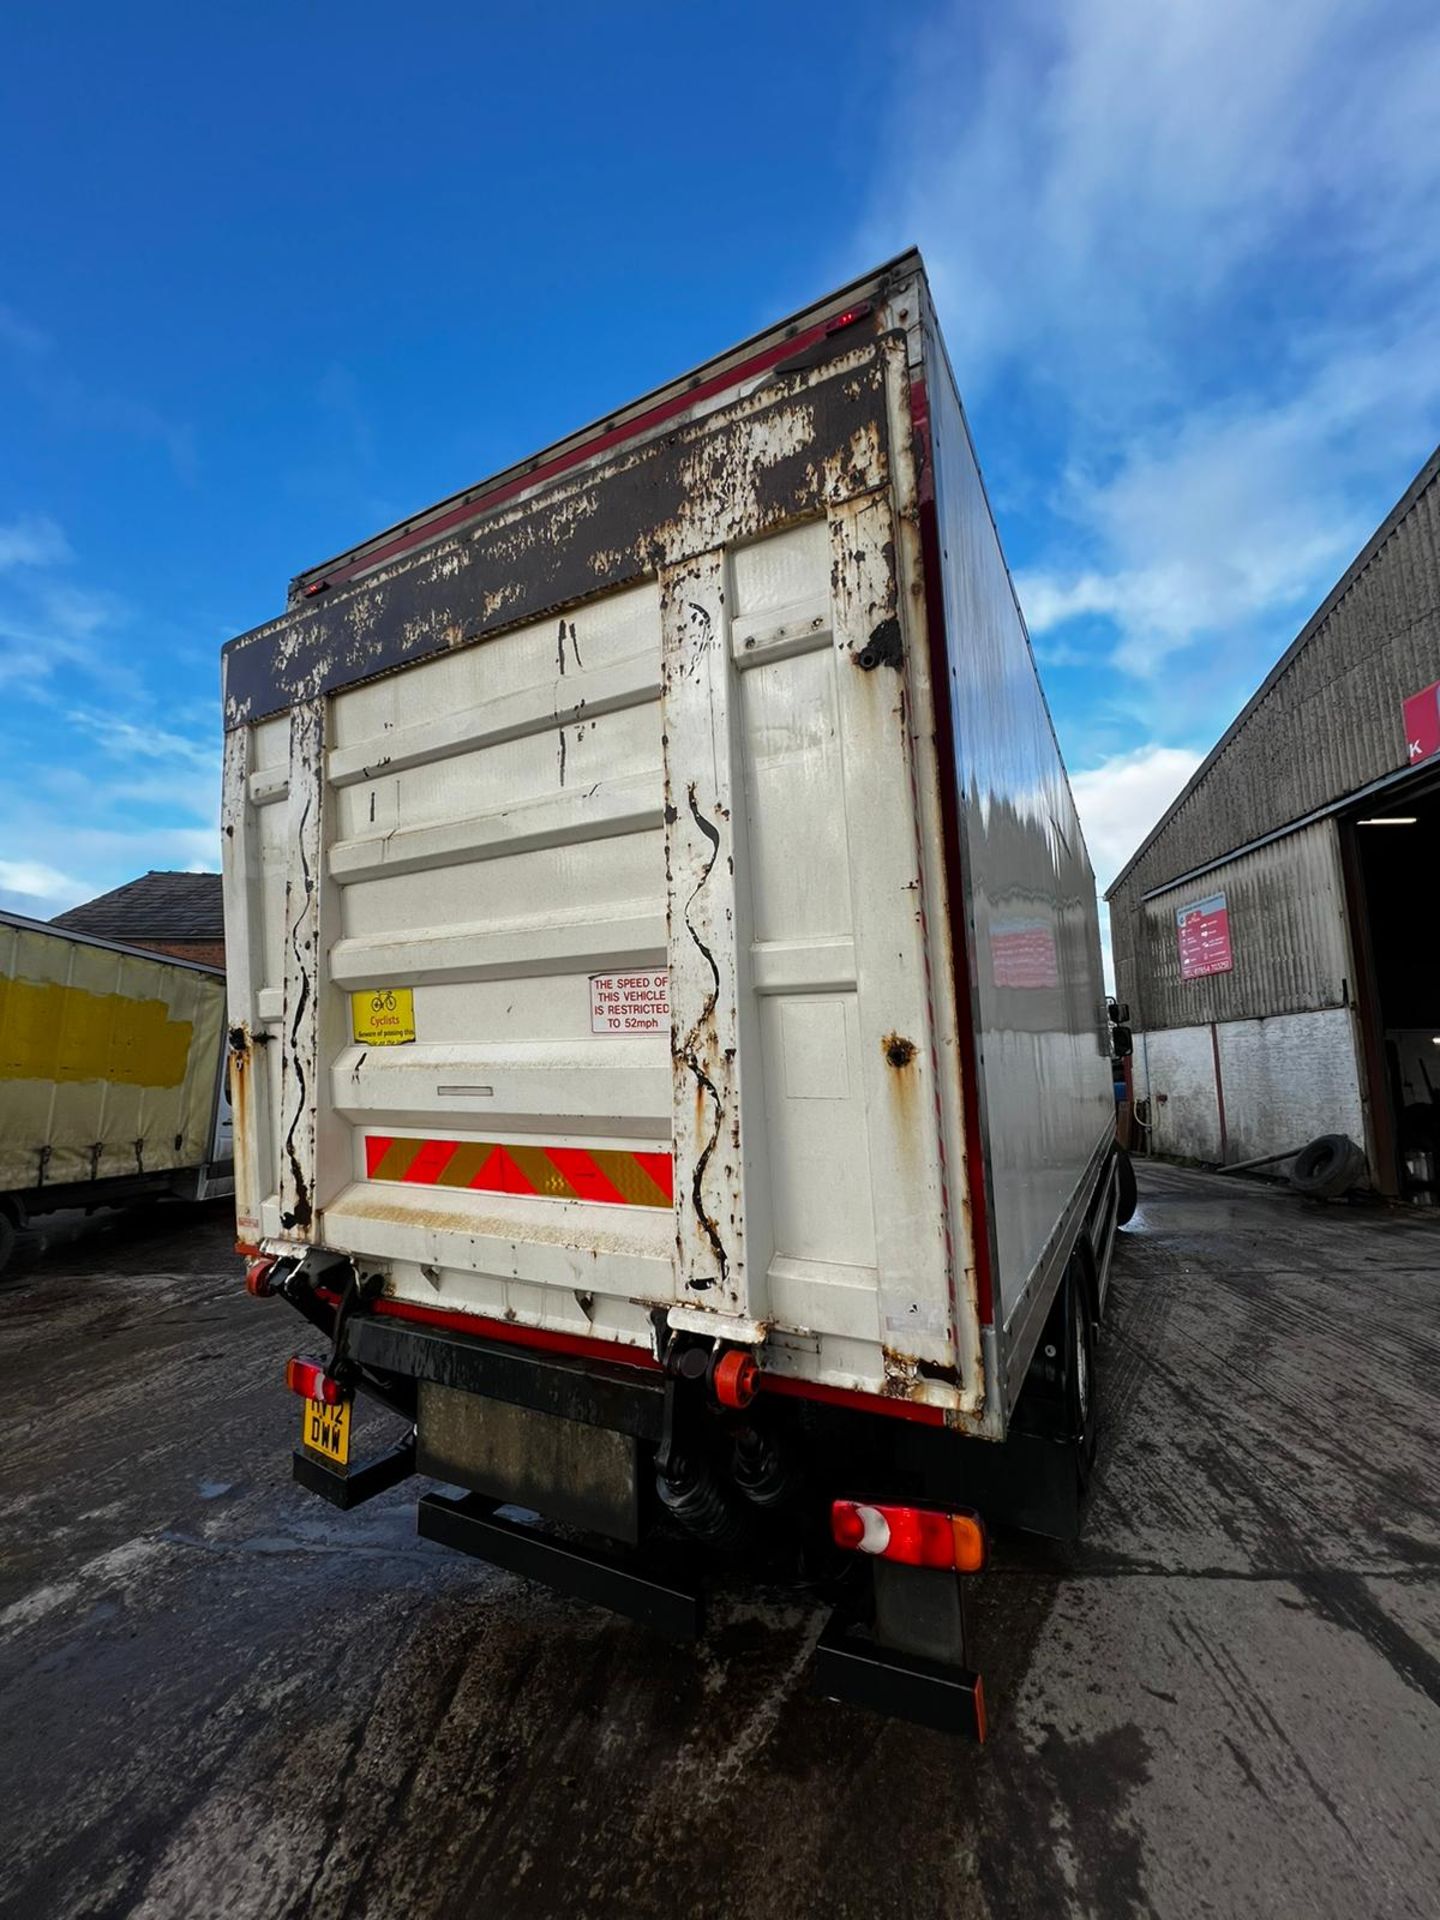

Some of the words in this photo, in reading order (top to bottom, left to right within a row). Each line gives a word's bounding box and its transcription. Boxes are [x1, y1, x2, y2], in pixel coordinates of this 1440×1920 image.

[1409, 739, 1423, 758] K
[595, 979, 613, 989] THE
[617, 978, 650, 989] SPEED
[654, 976, 669, 987] OF
[598, 991, 620, 1002] THIS
[623, 990, 666, 1001] VEHICLE
[594, 1005, 604, 1015] IS
[608, 1003, 670, 1015] RESTRICTED
[370, 1015, 400, 1028] Cyclists
[608, 1018, 620, 1028] TO
[624, 1018, 659, 1029] 52mph
[311, 1416, 340, 1454] DWW
